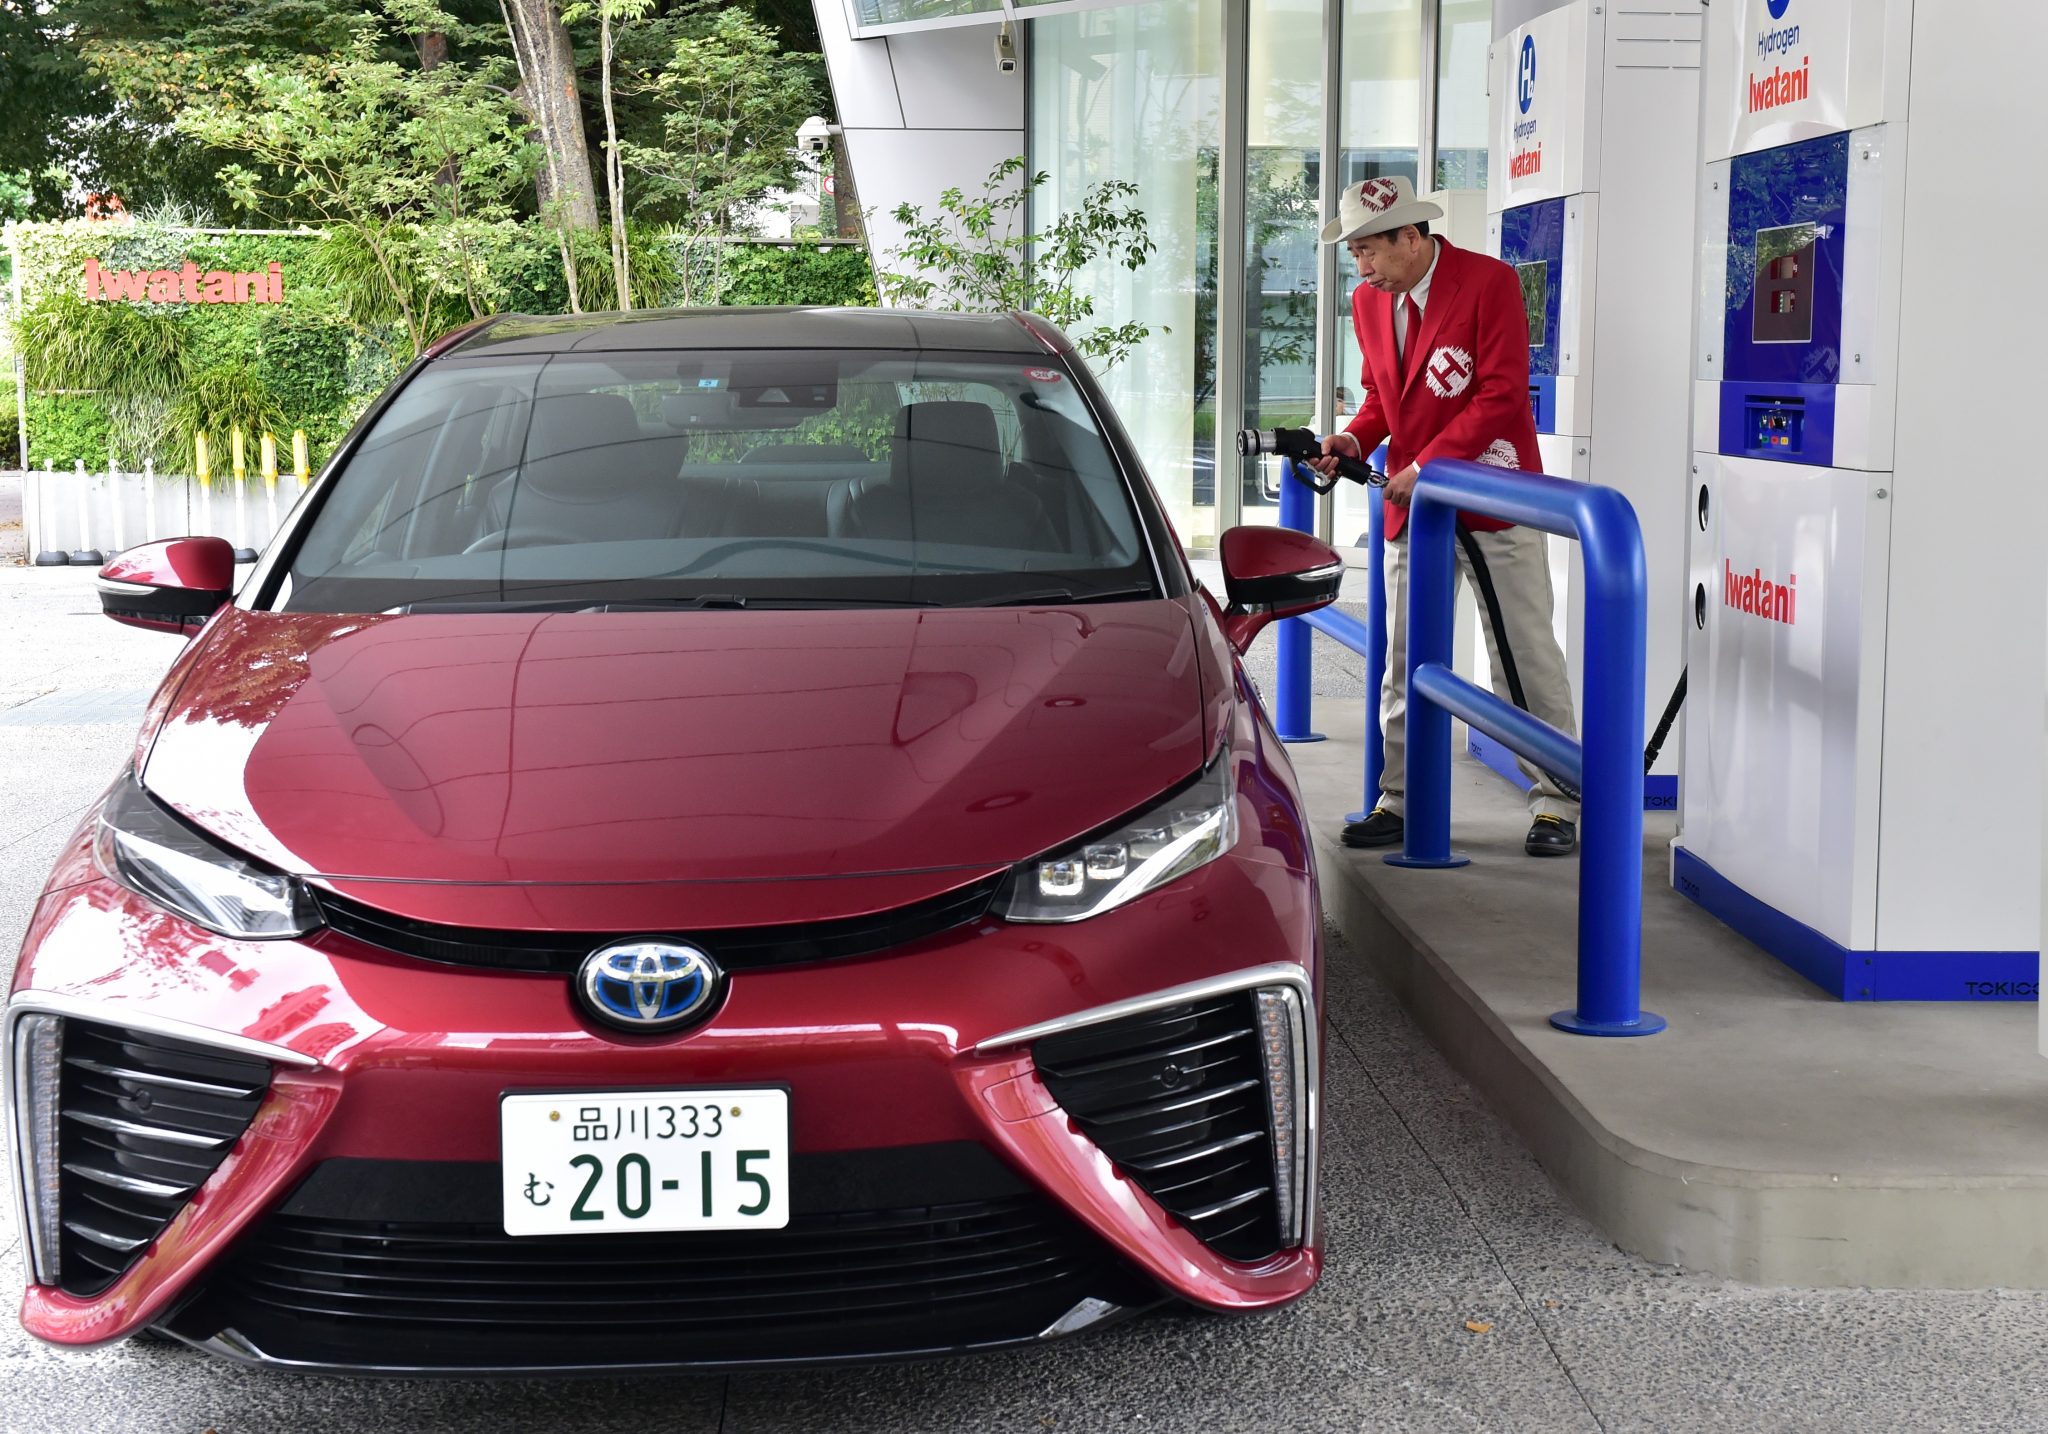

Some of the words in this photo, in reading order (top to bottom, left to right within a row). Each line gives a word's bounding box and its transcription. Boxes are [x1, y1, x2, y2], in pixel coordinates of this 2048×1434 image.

[1757, 24, 1799, 61] Hydrogen
[1749, 55, 1808, 113] Iwatani
[1513, 119, 1536, 143] Hydrogen
[1508, 141, 1541, 181] Iwatani
[85, 257, 283, 304] Iwatani
[1724, 558, 1797, 625] Iwatani
[1643, 796, 1678, 807] TOKI
[523, 1172, 555, 1207] む
[568, 1150, 772, 1221] 20-15
